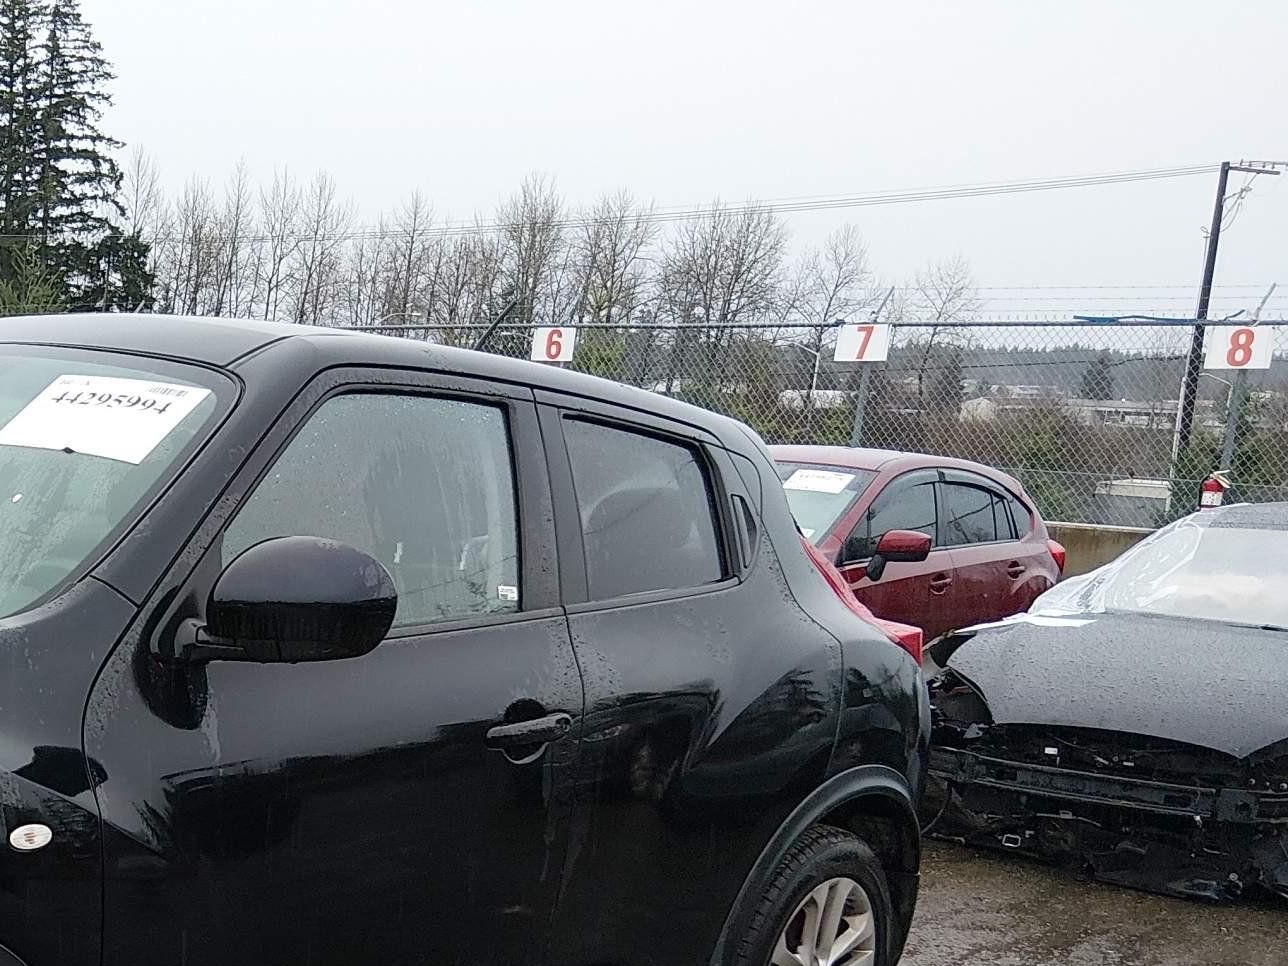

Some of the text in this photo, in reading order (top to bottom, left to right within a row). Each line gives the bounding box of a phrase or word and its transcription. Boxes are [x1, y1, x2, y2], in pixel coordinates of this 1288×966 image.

[545, 329, 563, 360] 6
[856, 326, 874, 360] 7
[1226, 328, 1255, 366] 8
[51, 391, 172, 414] 44295994
